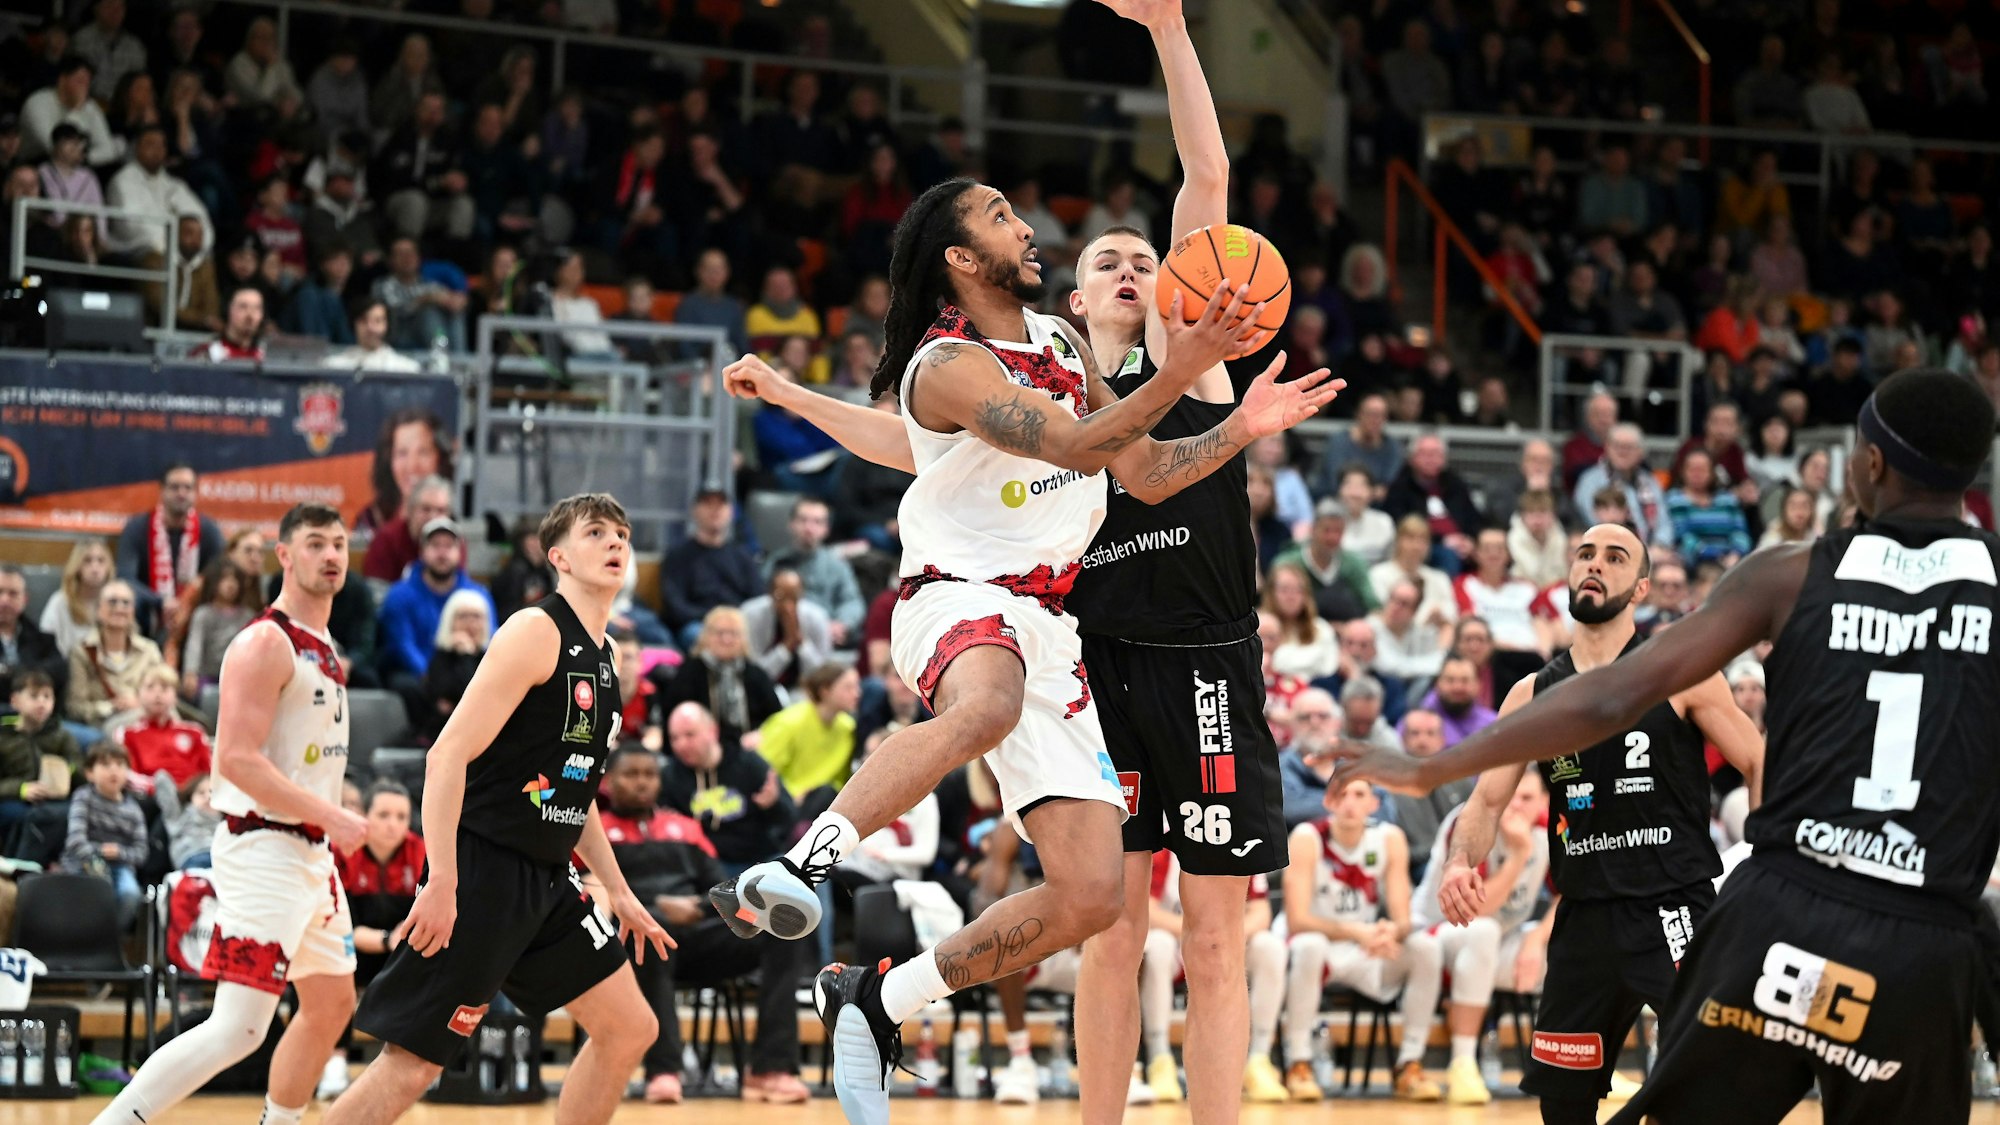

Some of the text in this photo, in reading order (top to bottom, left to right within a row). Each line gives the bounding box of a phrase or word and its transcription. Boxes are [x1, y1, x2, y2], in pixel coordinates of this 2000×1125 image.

[1082, 526, 1191, 569] estfalenWIND
[1882, 546, 1954, 575] HESSE
[1829, 603, 1992, 656] HUNT JR
[1217, 680, 1233, 752] NUTRITION
[565, 753, 595, 770] JUMP
[1625, 731, 1650, 769] 2
[1853, 670, 1924, 811] 1
[1179, 801, 1232, 845] 26
[1795, 818, 1926, 873] FOXWATCH
[1535, 1037, 1597, 1056] ROAD HOUSE
[1697, 996, 1902, 1082] ERNBOHRUNG
